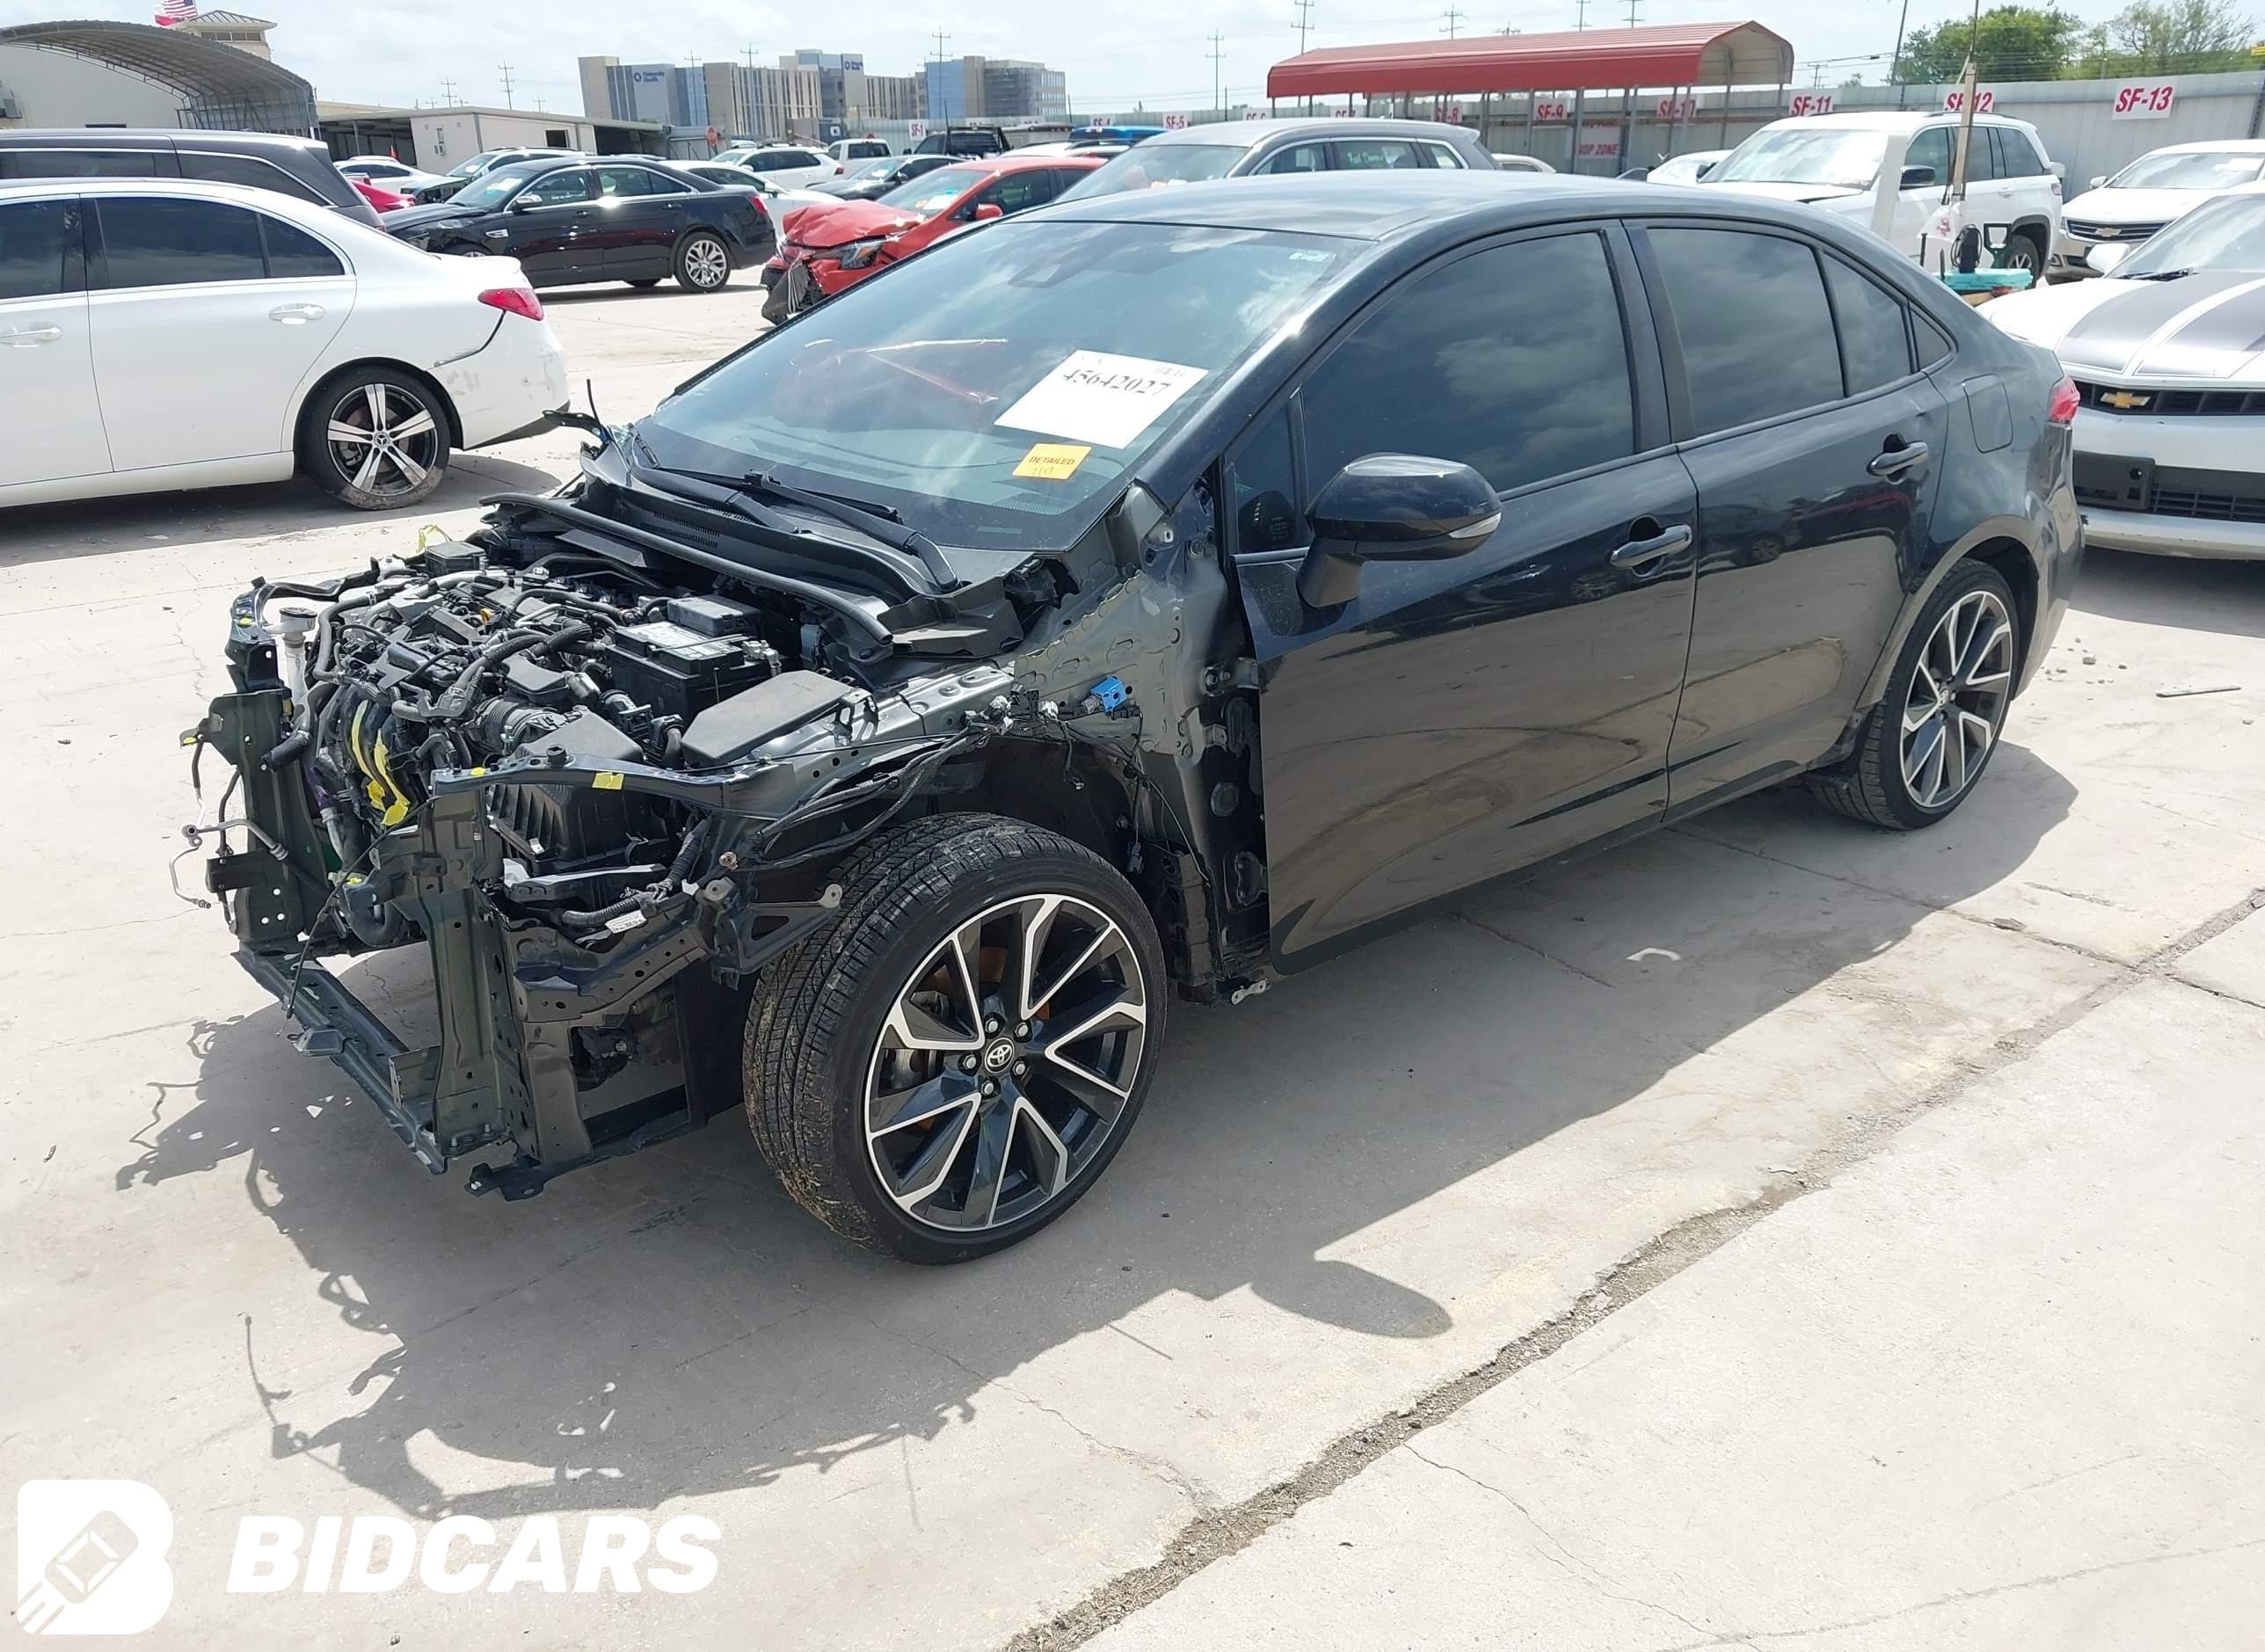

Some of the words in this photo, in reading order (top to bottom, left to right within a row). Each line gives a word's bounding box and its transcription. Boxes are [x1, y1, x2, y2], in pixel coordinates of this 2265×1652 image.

[1791, 96, 1832, 117] SF-11
[1945, 91, 1992, 113] SF12
[2116, 86, 2174, 113] SF-13
[1536, 104, 1563, 120] SF-9
[911, 123, 923, 137] SF-1
[1166, 115, 1184, 129] SF-5
[1063, 368, 1172, 397] 45642027
[1029, 456, 1075, 465] DETAILED
